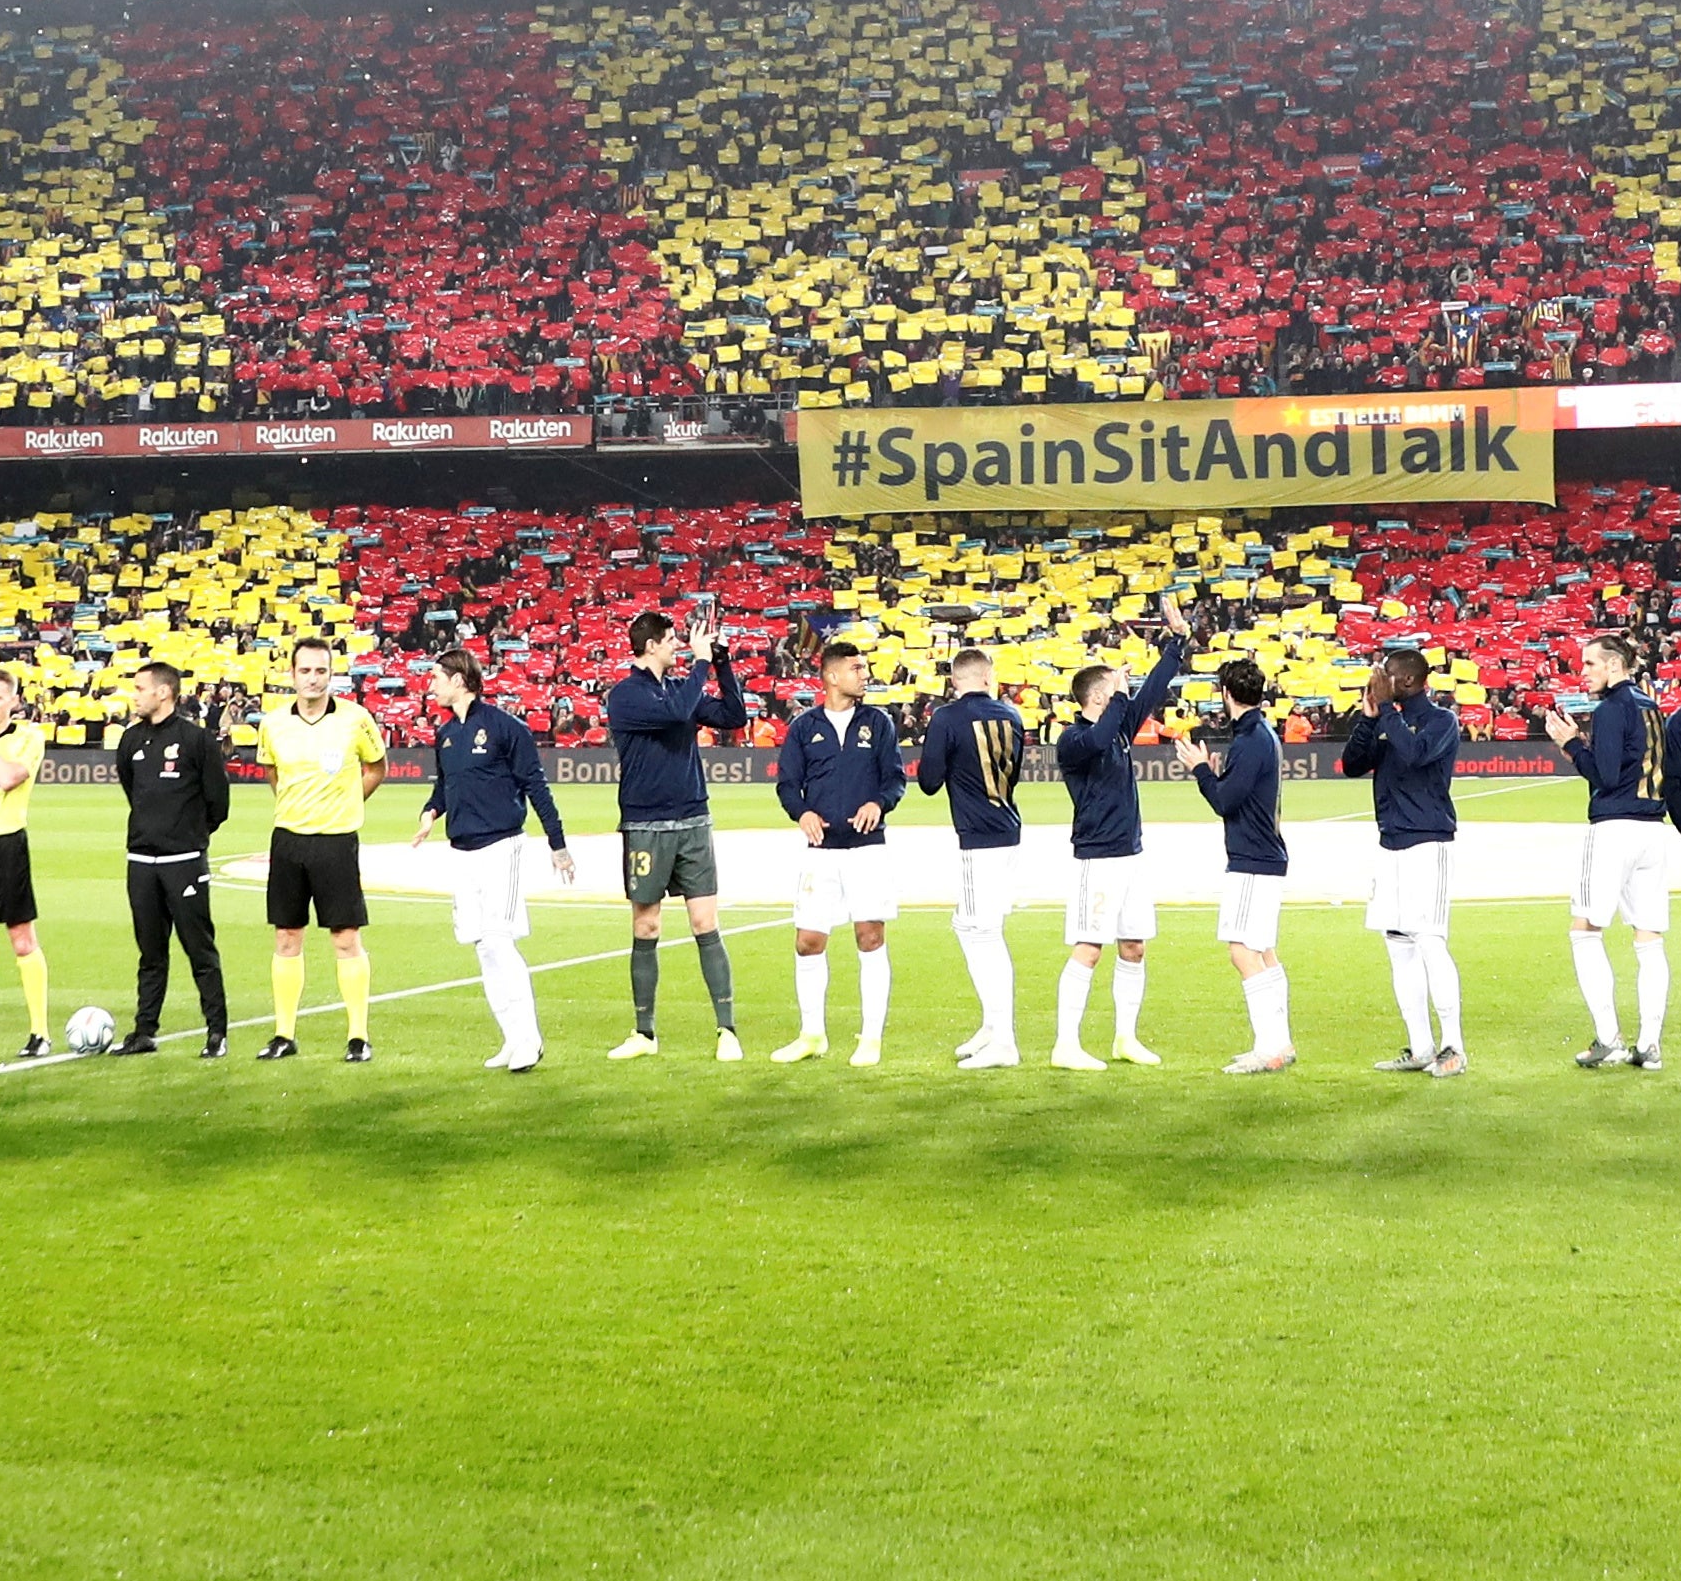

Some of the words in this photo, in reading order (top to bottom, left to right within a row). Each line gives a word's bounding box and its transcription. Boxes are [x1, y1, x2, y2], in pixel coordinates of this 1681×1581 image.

[1310, 408, 1401, 426] ESTRELLA
[139, 427, 218, 446] Rakuten
[256, 424, 335, 444] Rakuten
[372, 421, 452, 440] Rakuten
[490, 419, 571, 438] Rakuten
[25, 430, 103, 448] Rakuten
[833, 406, 1519, 501] #SpainSitAndTalk
[40, 759, 118, 783] Bones
[557, 758, 620, 782] Bone
[706, 758, 752, 781] tes!
[629, 851, 651, 876] 13
